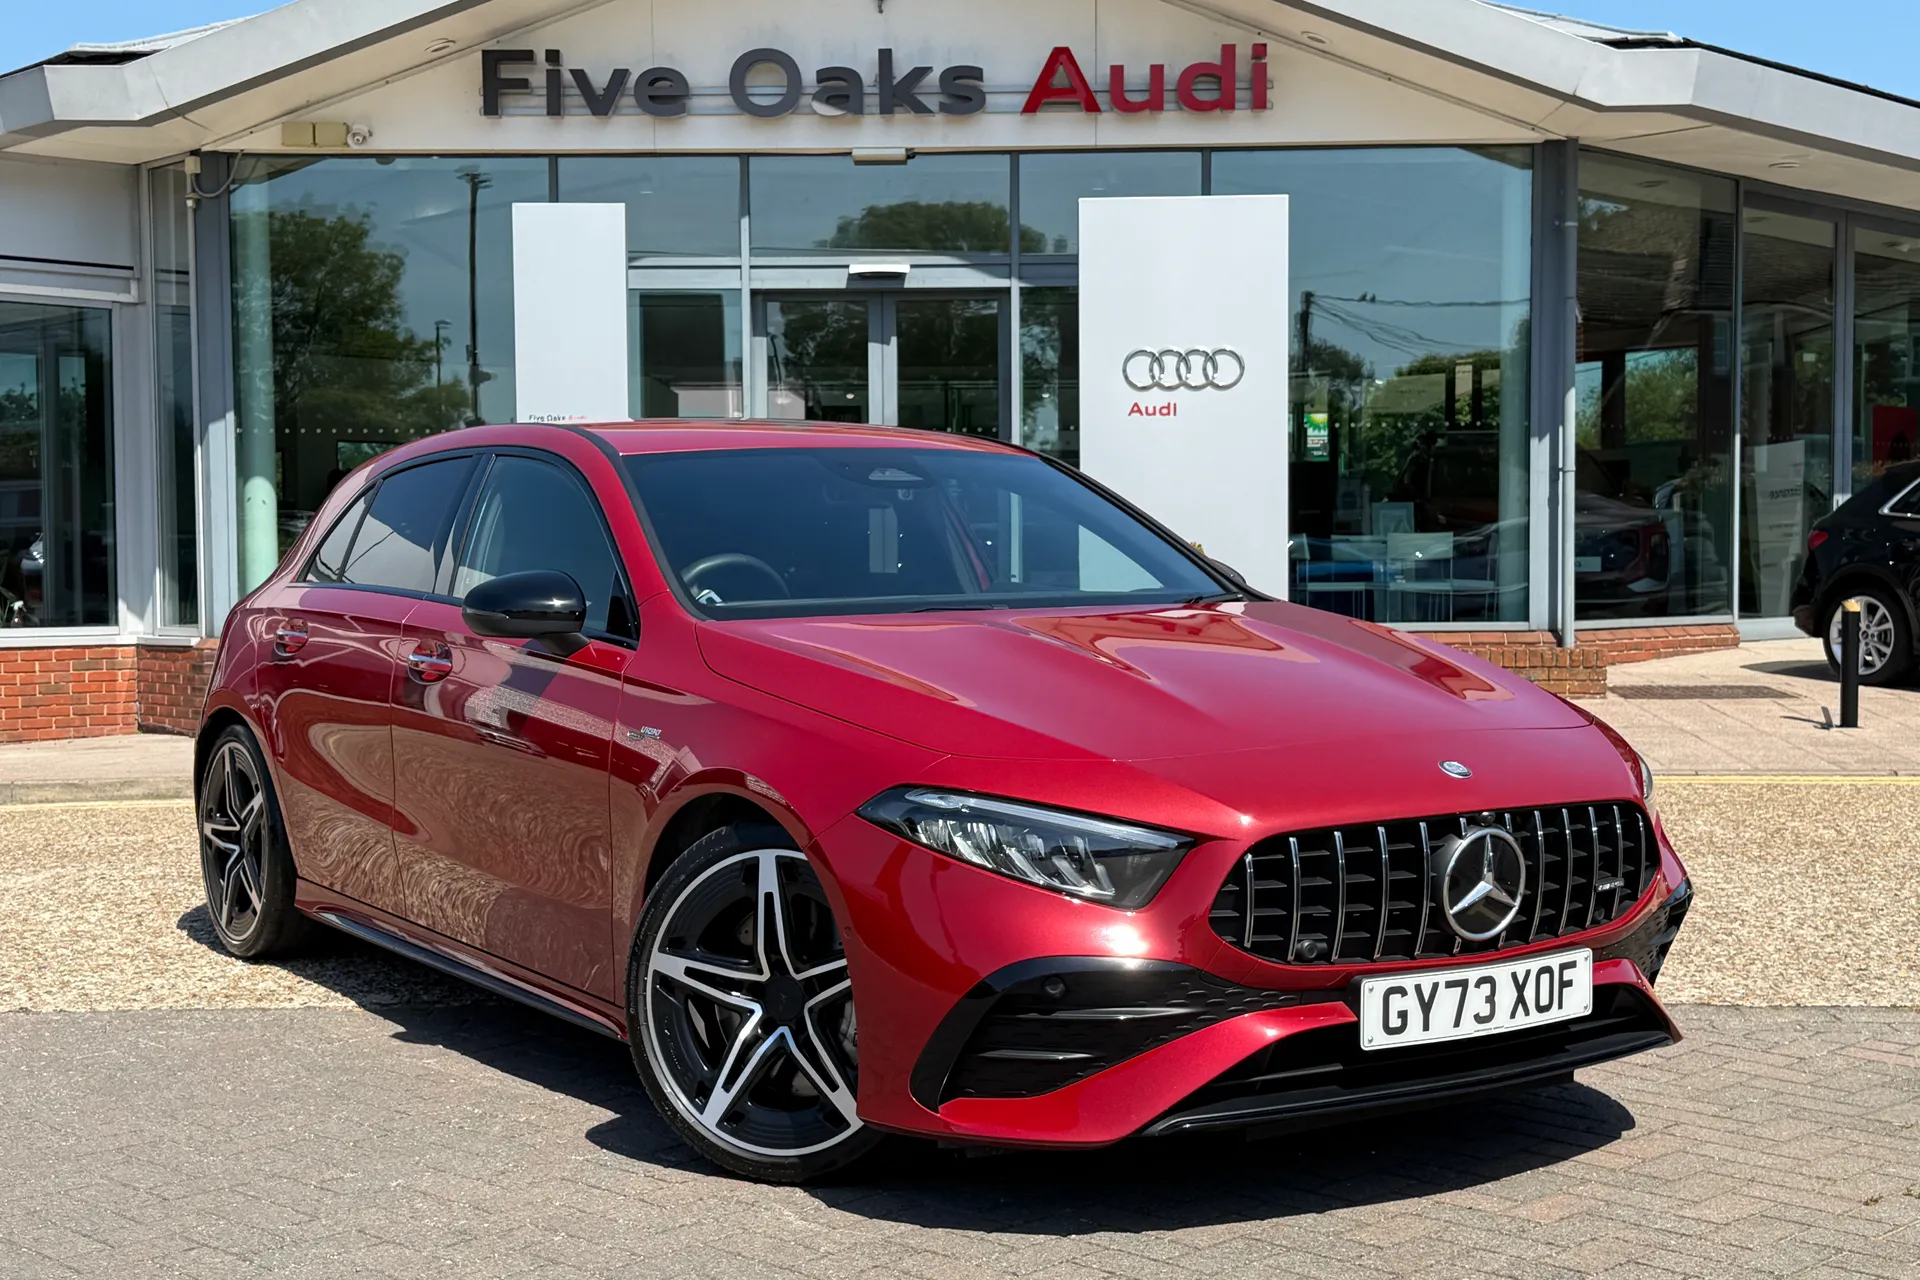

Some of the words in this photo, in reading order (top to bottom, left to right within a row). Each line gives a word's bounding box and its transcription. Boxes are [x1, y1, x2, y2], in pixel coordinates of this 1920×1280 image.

[481, 48, 690, 118] Five
[728, 47, 987, 118] Oaks
[1020, 42, 1268, 115] Audi
[1128, 401, 1177, 417] Audi
[1381, 975, 1498, 1036] GY73
[1509, 959, 1578, 1020] XOF
